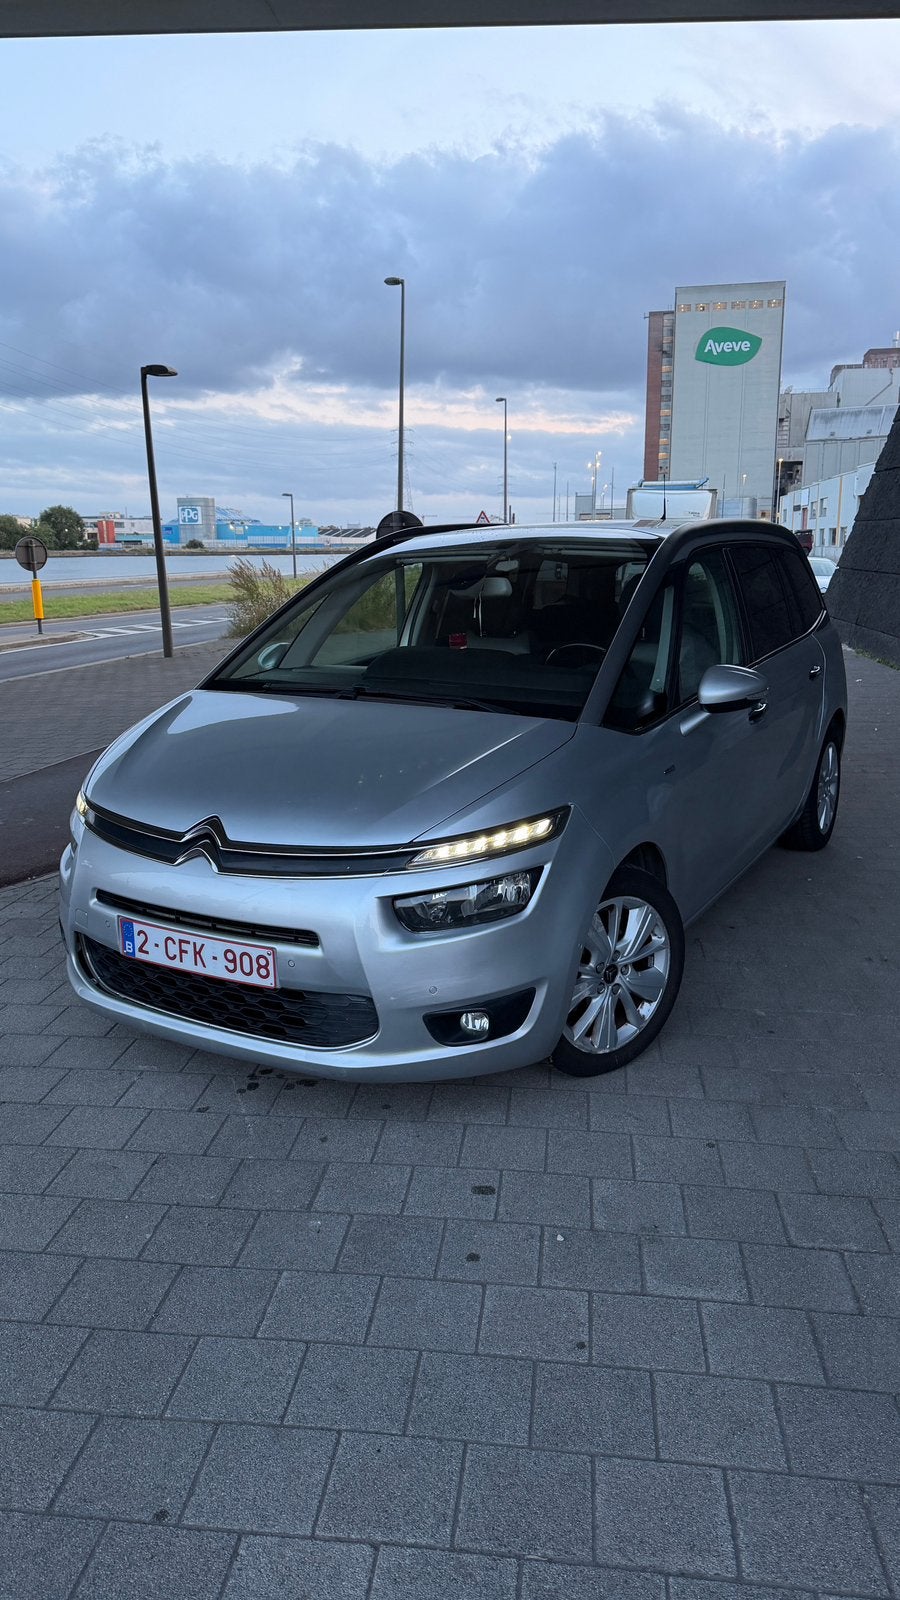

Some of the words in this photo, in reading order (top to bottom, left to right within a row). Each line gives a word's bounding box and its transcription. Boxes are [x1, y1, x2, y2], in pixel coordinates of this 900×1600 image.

[704, 339, 751, 355] Aveve
[181, 508, 198, 522] PPG
[126, 940, 133, 953] B
[136, 929, 271, 980] 2-CFK-908
